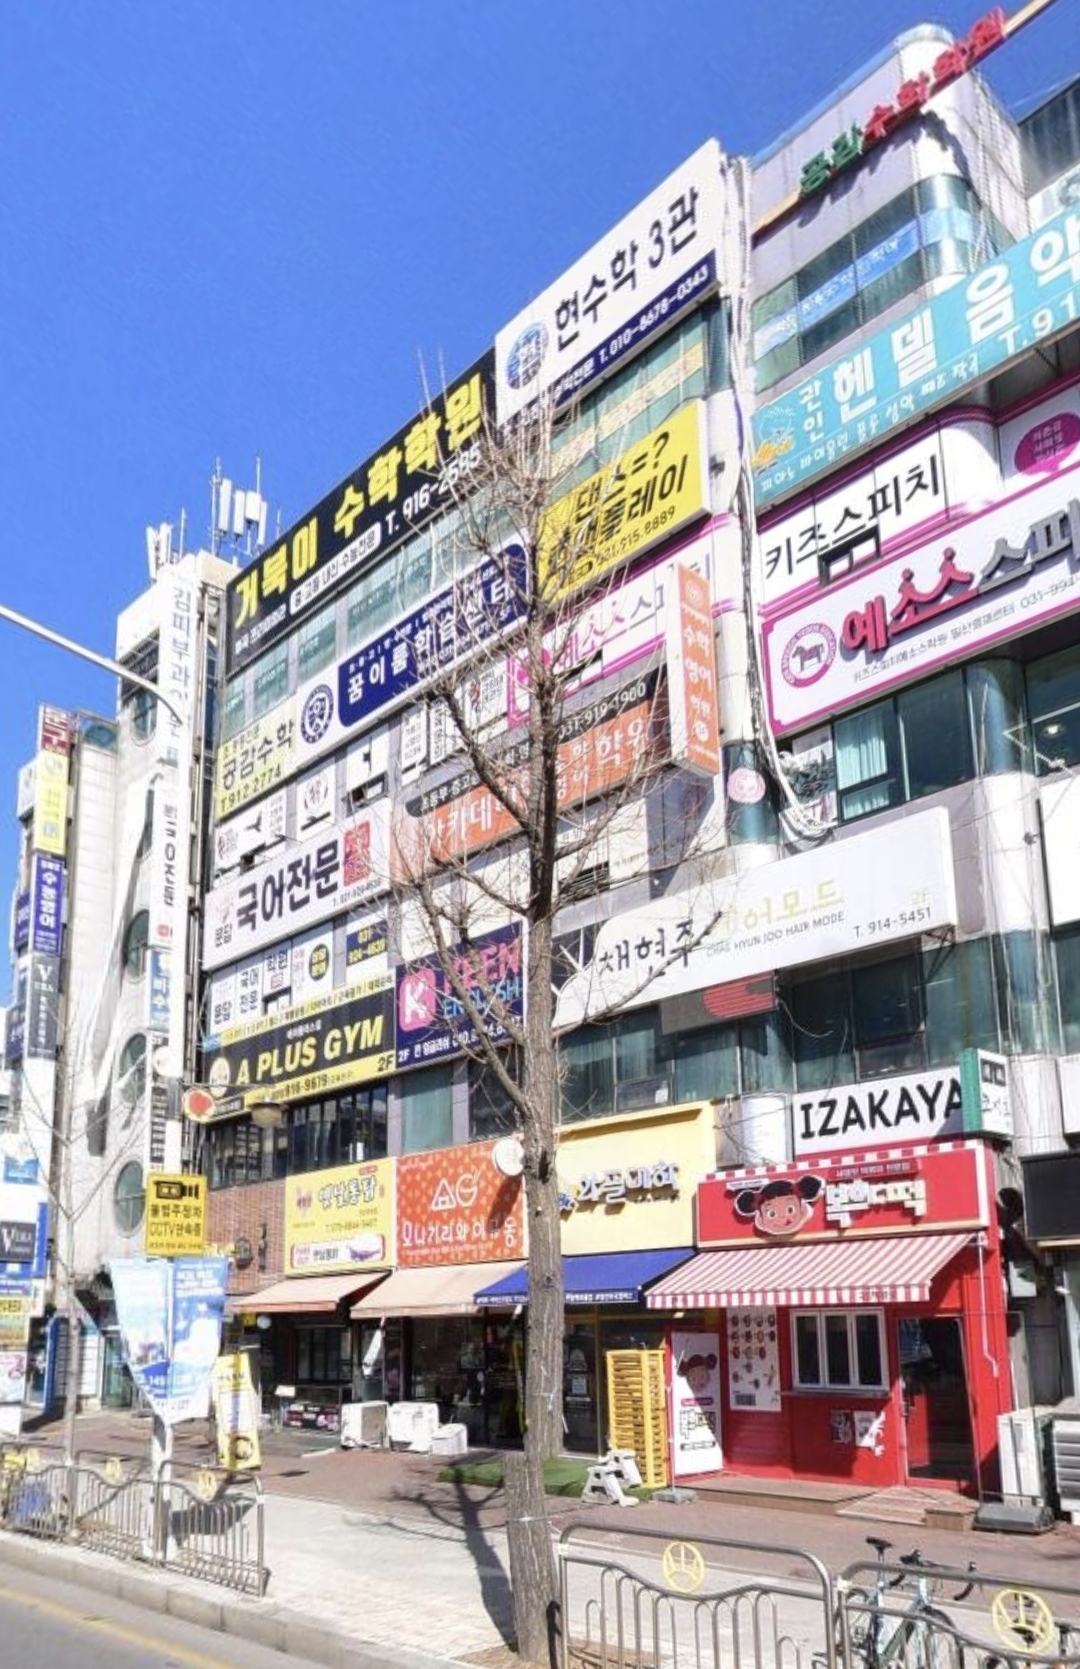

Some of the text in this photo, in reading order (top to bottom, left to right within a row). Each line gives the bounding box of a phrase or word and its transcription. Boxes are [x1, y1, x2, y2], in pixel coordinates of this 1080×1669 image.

[555, 240, 639, 351] 현수학
[648, 186, 699, 269] 3관
[234, 372, 481, 629] 거북이 수학학원
[765, 453, 940, 580] 키즈스피치
[222, 719, 295, 791] 공감수학
[236, 839, 340, 932] 국어전문
[598, 918, 694, 977] 채현주
[734, 933, 762, 951] HYUN
[763, 929, 783, 945] JOO
[785, 921, 810, 937] HAIR
[812, 910, 845, 928] MODE
[867, 905, 932, 935] 914-5451
[405, 981, 428, 1024] K
[236, 1058, 251, 1087] A
[256, 1036, 318, 1081] PLUS
[323, 1014, 385, 1061] GYM
[800, 1077, 963, 1140] IZAKAYA
[150, 1203, 202, 1219] 불법주정차
[578, 1162, 681, 1204] 와플대학
[149, 1221, 202, 1238] CCTV단속중
[402, 1219, 468, 1247] 오니기리와
